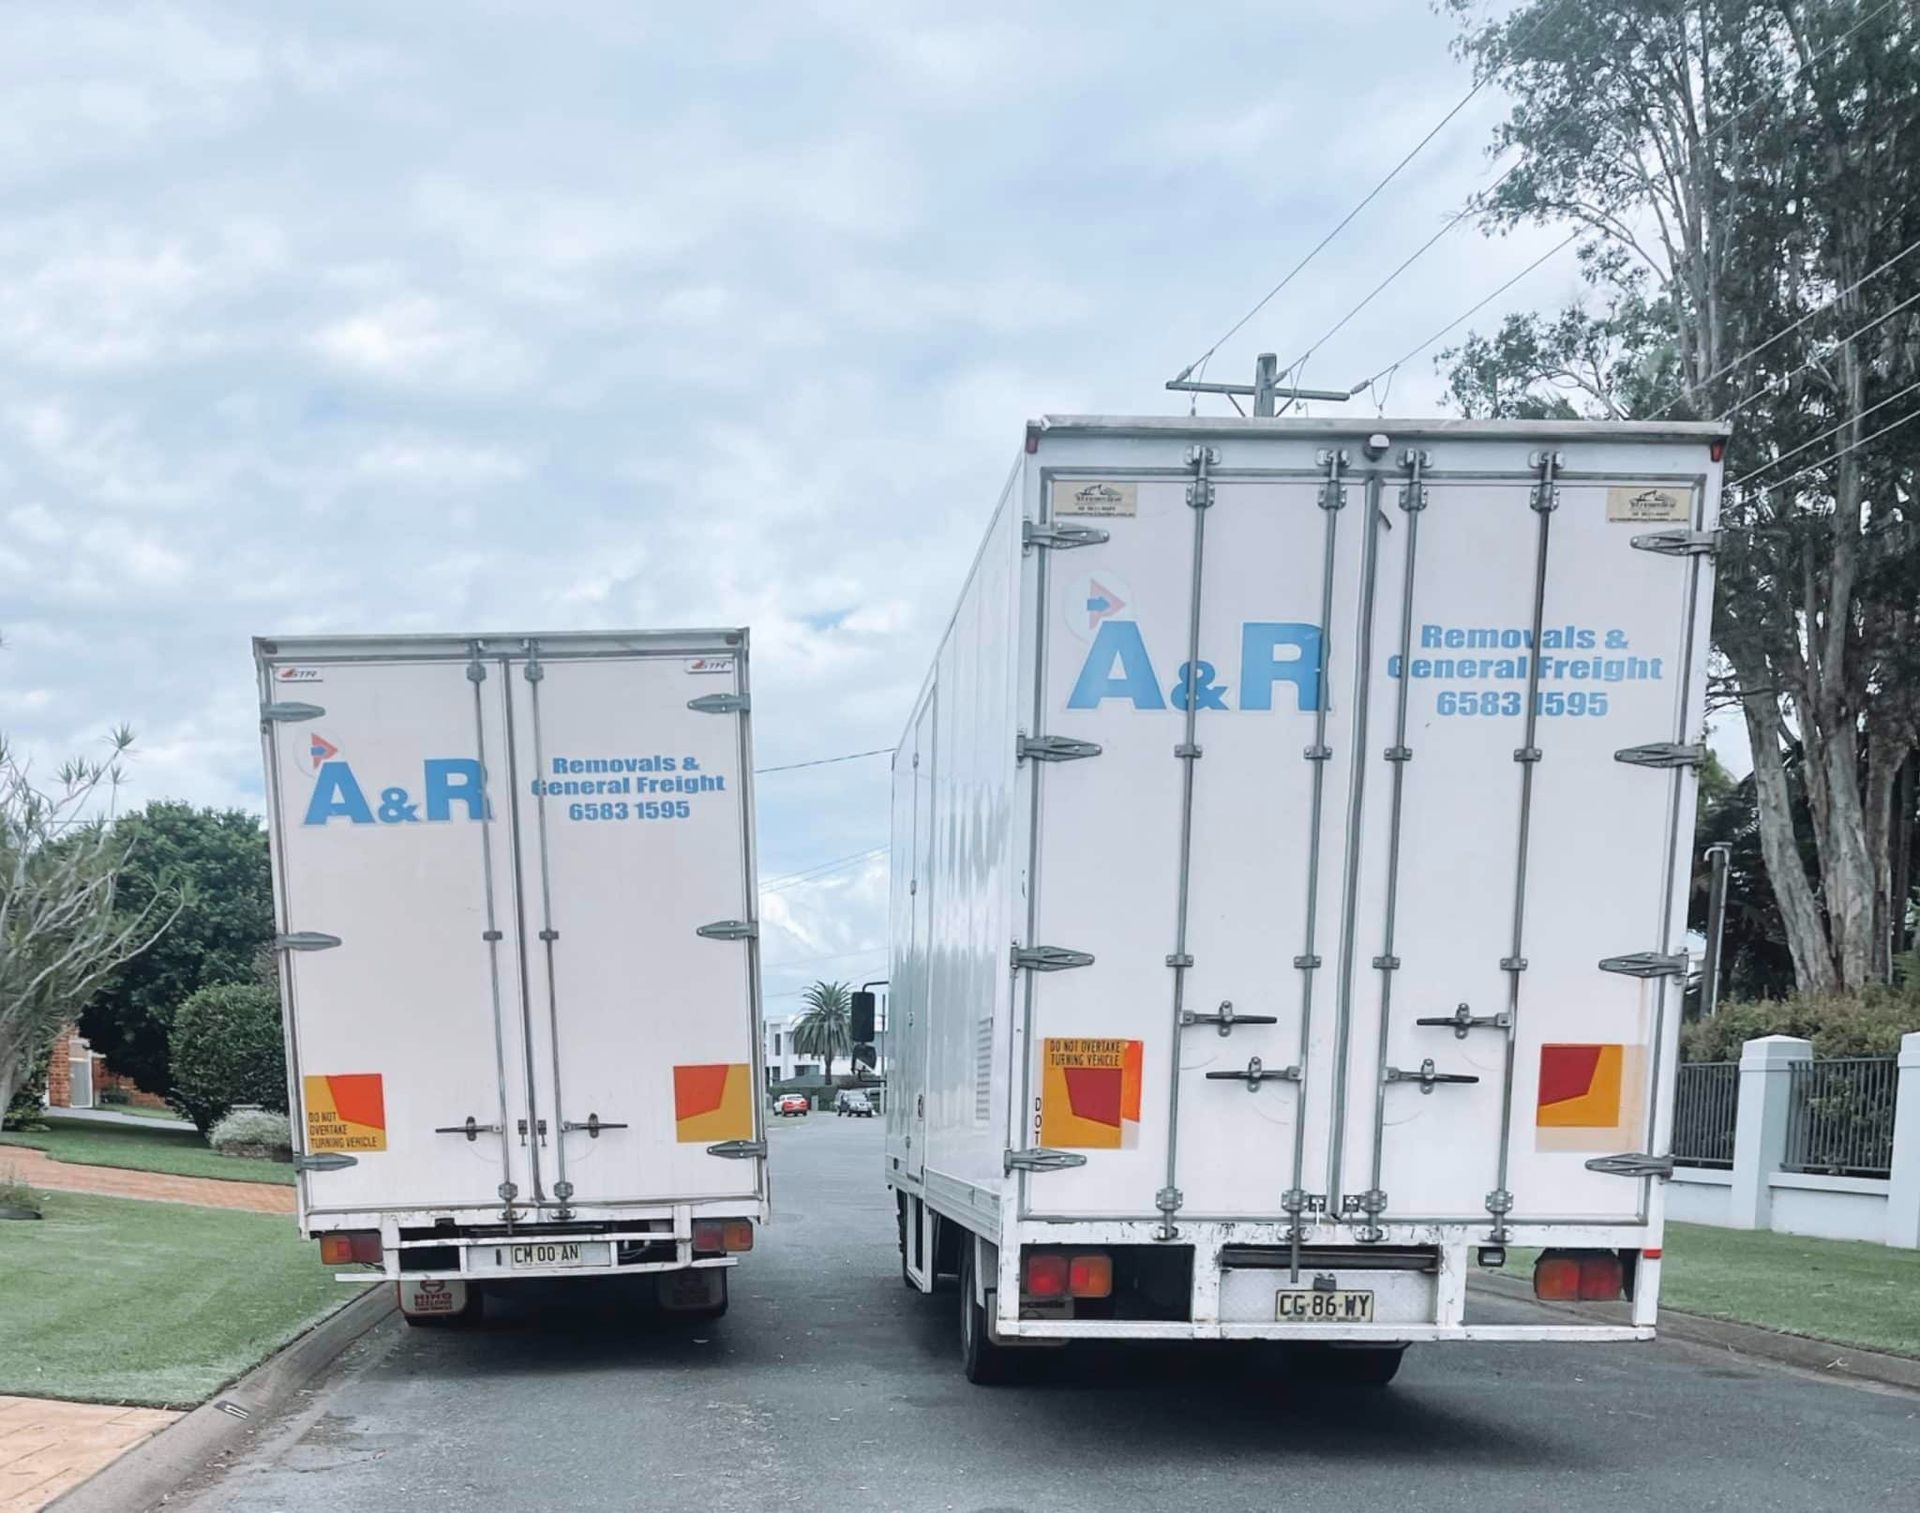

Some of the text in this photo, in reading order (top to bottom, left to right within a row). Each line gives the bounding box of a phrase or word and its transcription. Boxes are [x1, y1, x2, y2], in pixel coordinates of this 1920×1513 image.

[1604, 628, 1629, 650] &
[1066, 620, 1331, 712] A&R
[1535, 655, 1663, 682] Freight
[1436, 690, 1609, 717] 6583 1595
[552, 755, 702, 775] Removals &
[303, 758, 492, 826] A&R
[530, 774, 726, 797] General Freight
[569, 800, 691, 822] 6583 1595
[1050, 1040, 1121, 1053] DO NOT OVERTAKE
[1051, 1054, 1120, 1067] TURNING VEHICLE
[308, 1111, 337, 1123] DO NOT
[309, 1124, 348, 1136] OVERTAKE
[310, 1136, 377, 1148] TURNING VEHICLE
[514, 1245, 533, 1263] CM
[561, 1244, 579, 1261] AN
